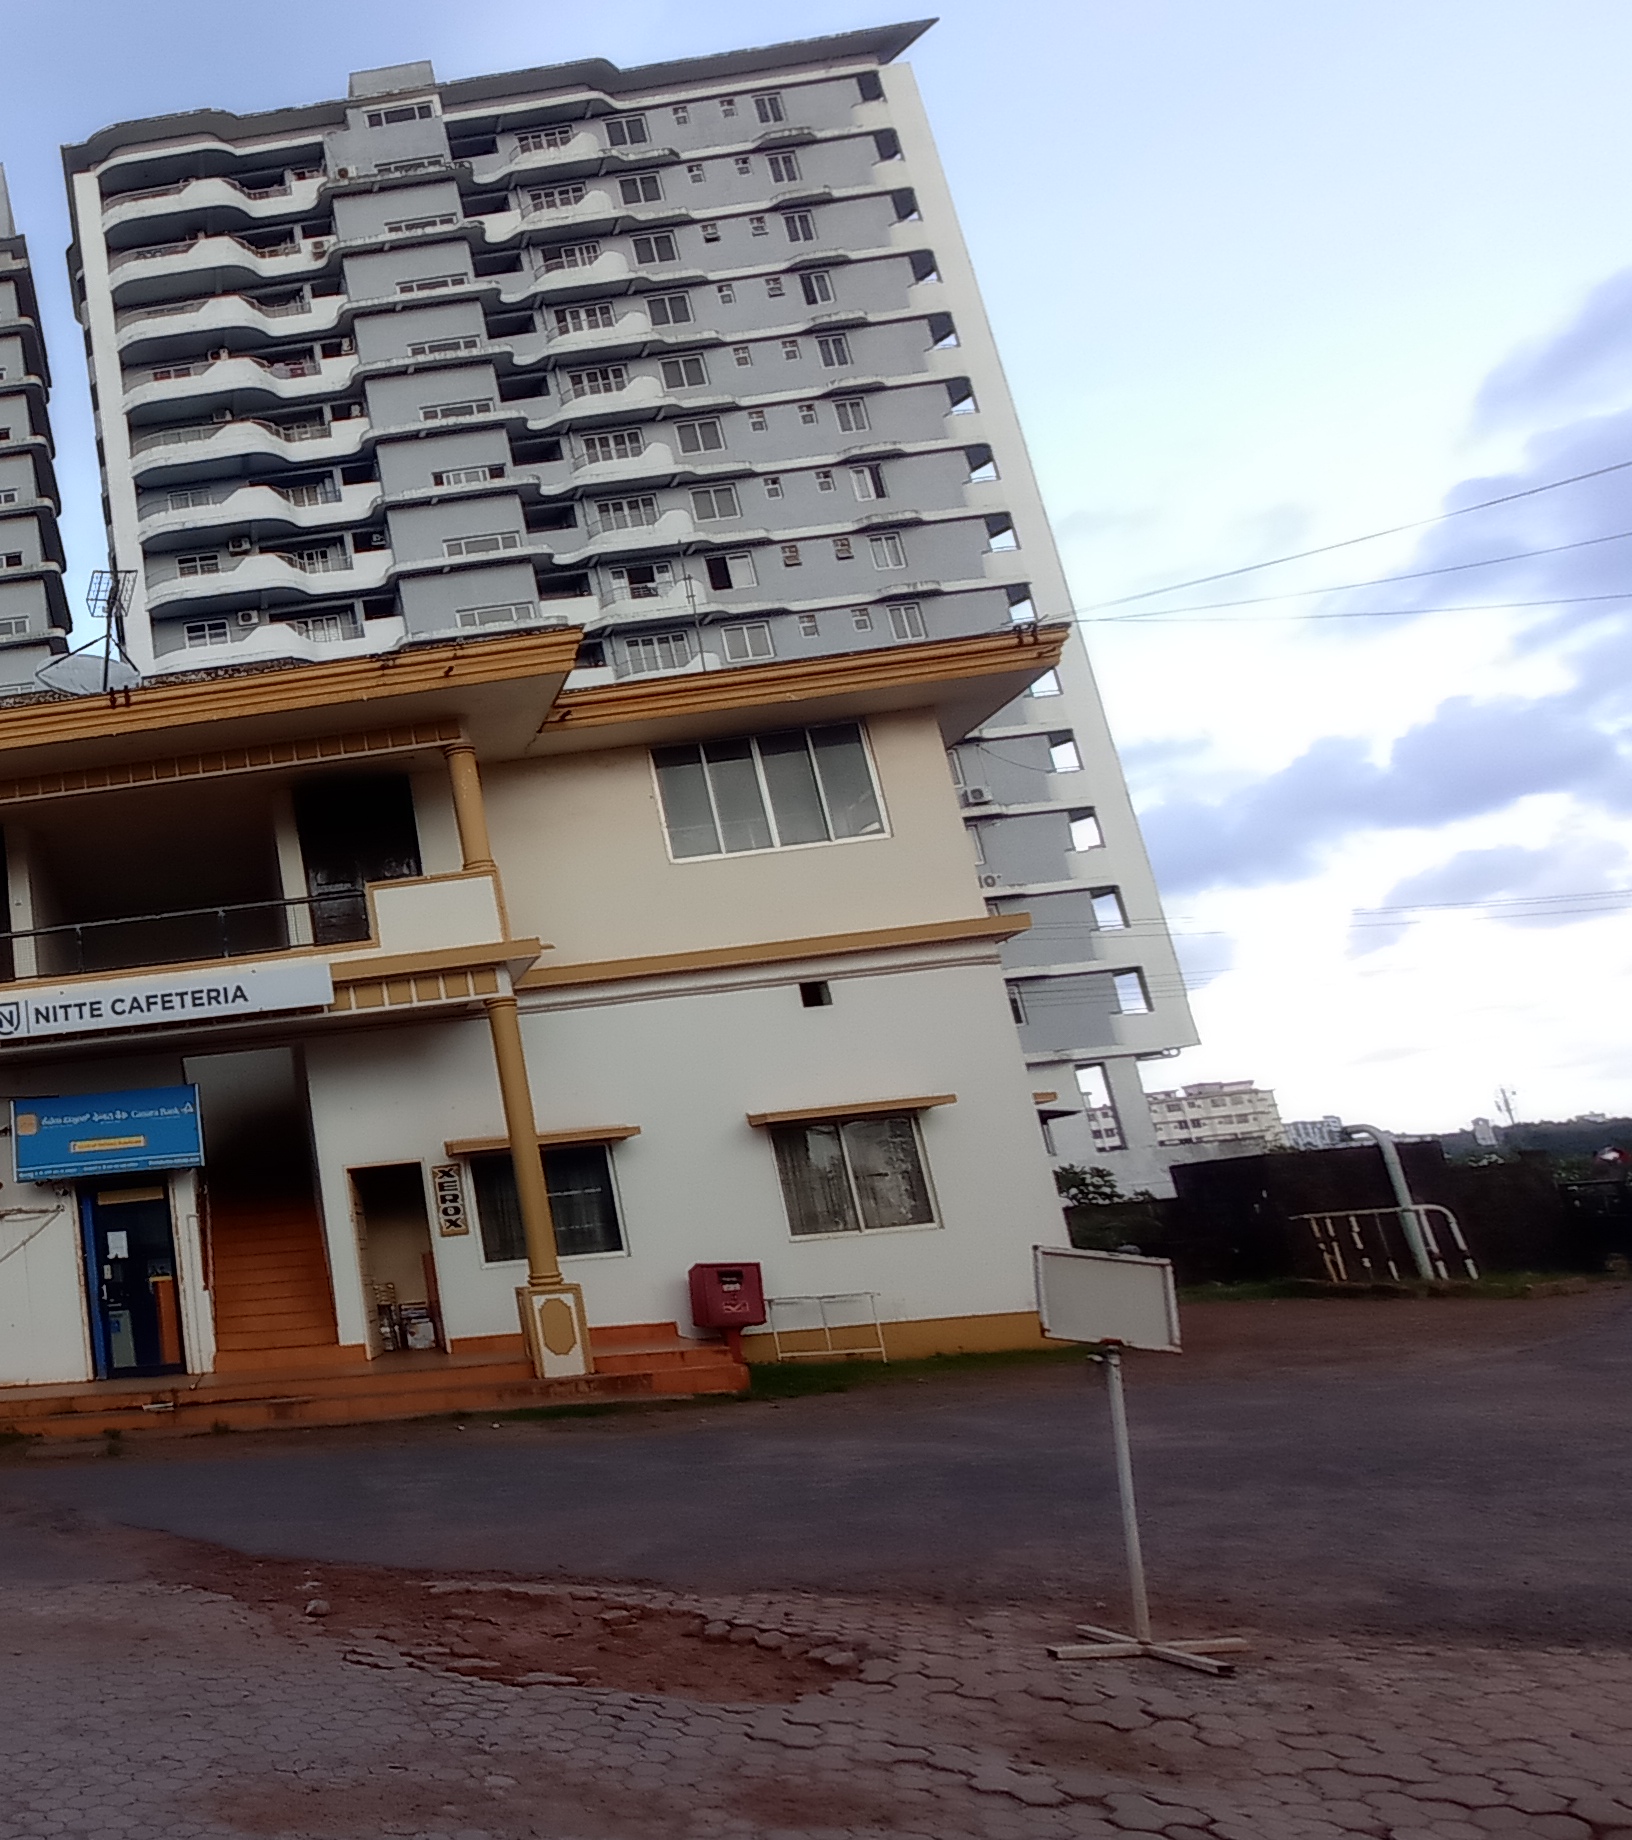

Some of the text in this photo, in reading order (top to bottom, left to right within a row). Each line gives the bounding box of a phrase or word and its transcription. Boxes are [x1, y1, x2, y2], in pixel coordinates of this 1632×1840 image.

[34, 984, 249, 1025] NITTE CAFETERIA
[437, 1167, 463, 1230] XEROX
